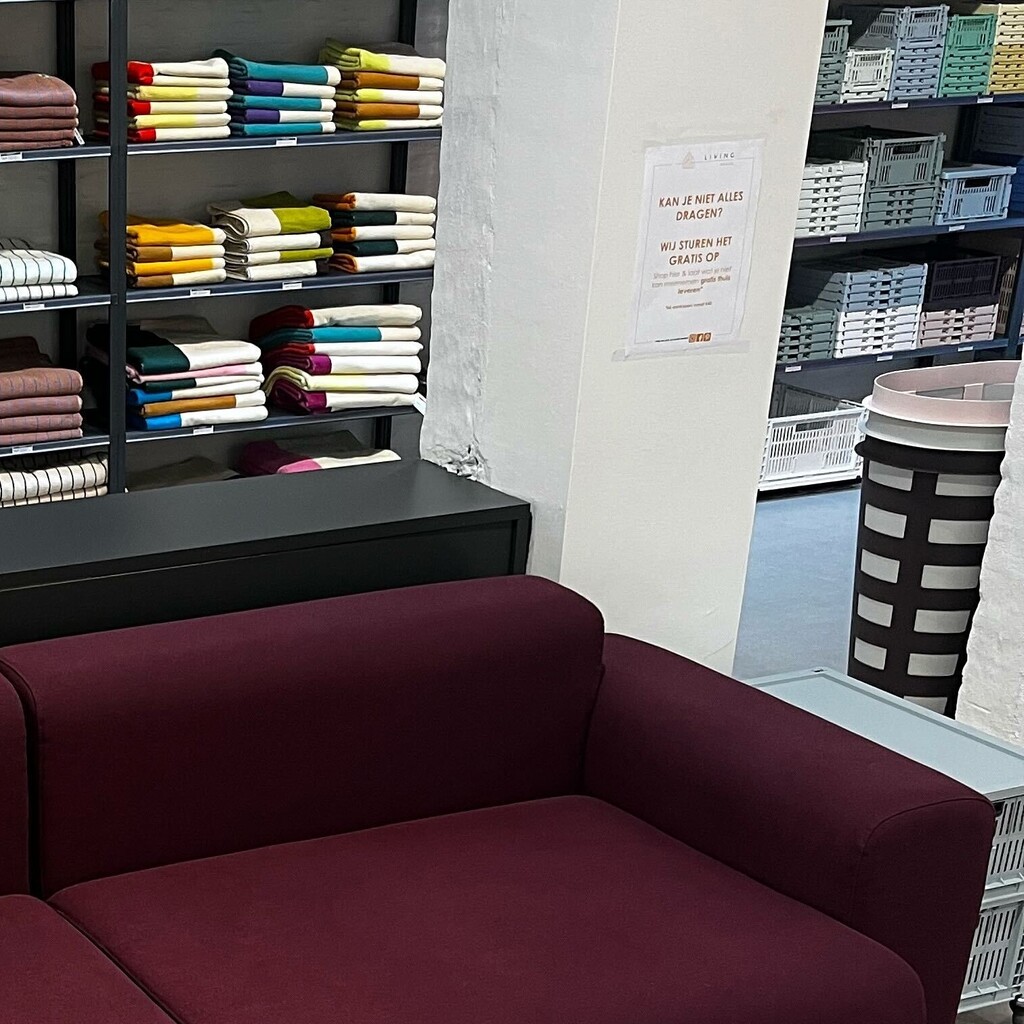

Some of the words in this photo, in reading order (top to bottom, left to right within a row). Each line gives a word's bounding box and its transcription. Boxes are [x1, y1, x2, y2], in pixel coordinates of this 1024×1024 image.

[704, 152, 735, 161] LIVING
[658, 197, 679, 208] KAN
[682, 195, 693, 206] JE
[694, 193, 715, 205] NIET
[717, 191, 744, 203] ALLES
[675, 207, 723, 221] DRAGEN?
[660, 241, 677, 252] WIJ
[679, 239, 714, 251] STUREN
[716, 236, 733, 247] HET
[669, 253, 703, 266] GRATIS
[705, 252, 720, 263] OP
